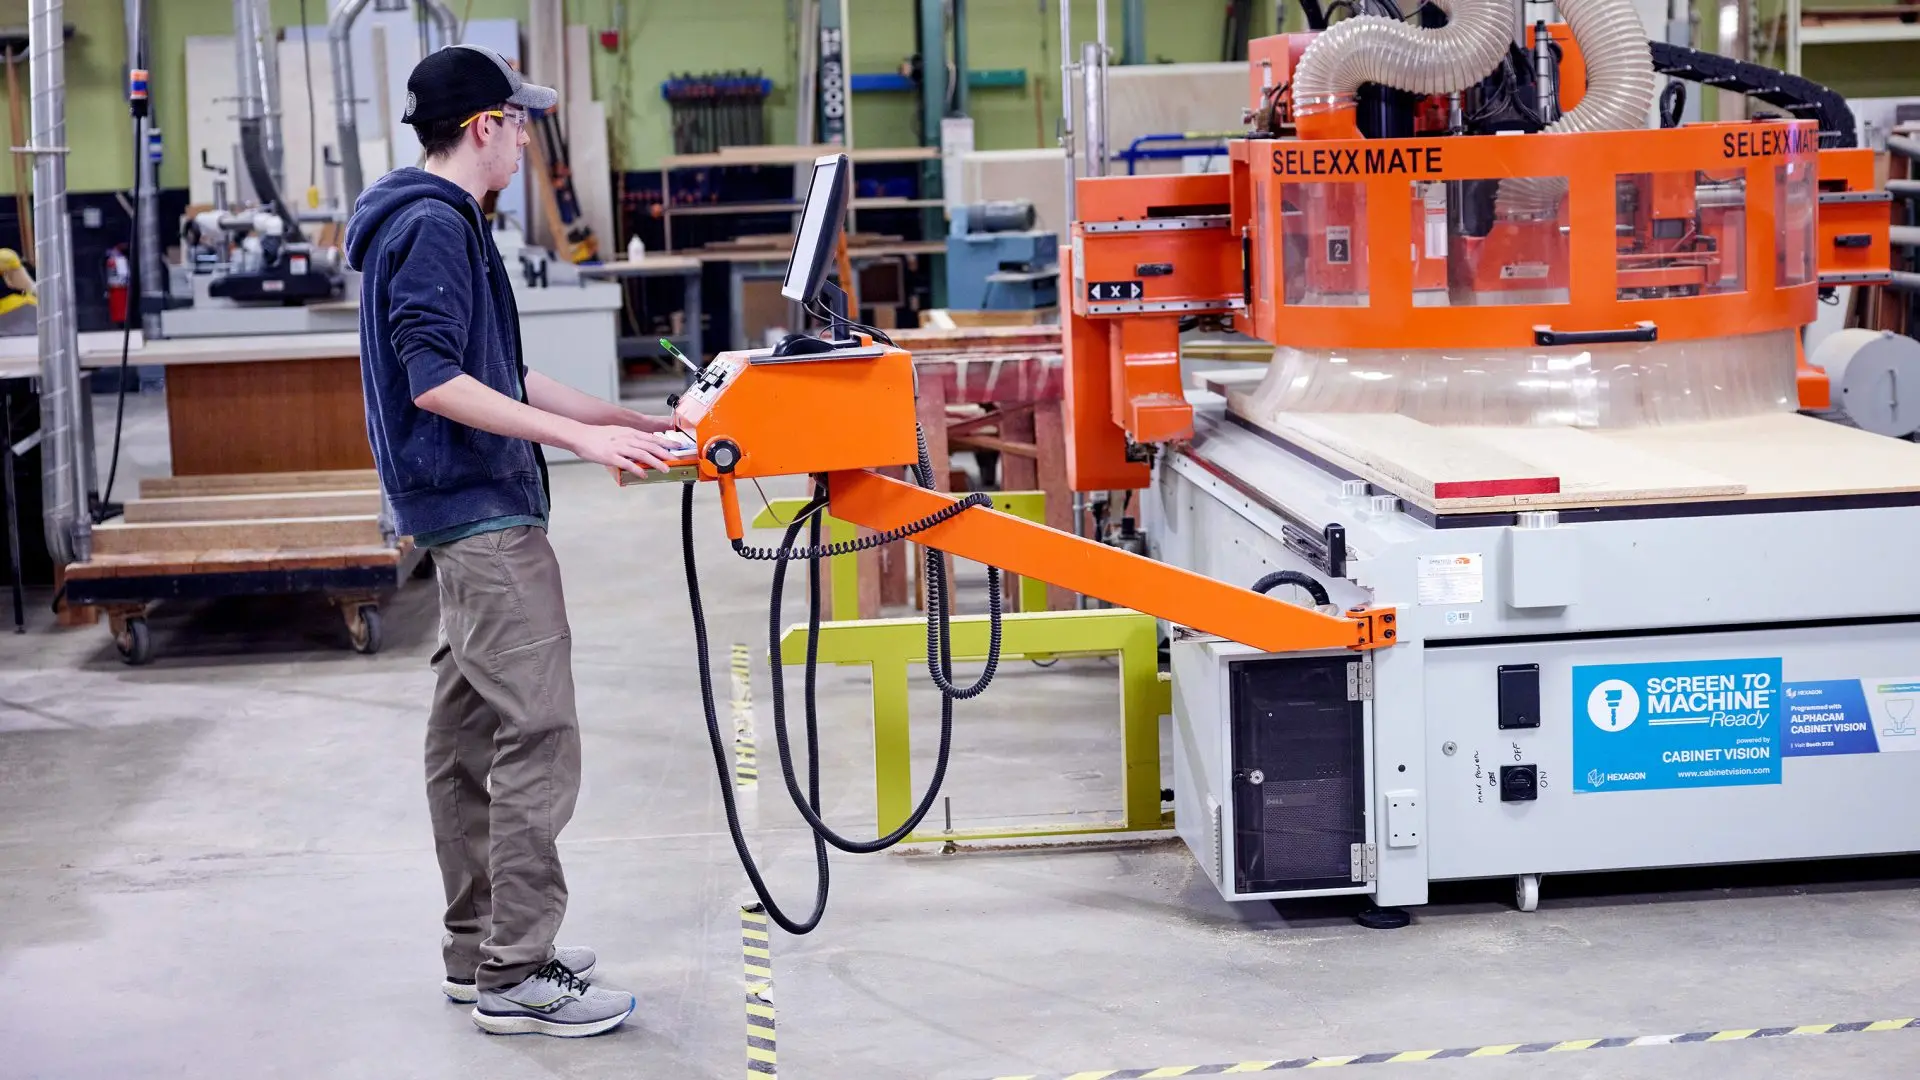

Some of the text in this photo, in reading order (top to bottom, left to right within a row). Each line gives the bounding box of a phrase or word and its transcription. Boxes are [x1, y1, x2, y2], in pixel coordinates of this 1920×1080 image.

[1723, 129, 1791, 158] SELEXX
[1272, 147, 1443, 175] SELEXX MATE
[1335, 243, 1343, 258] 2
[1110, 285, 1121, 297] X
[1647, 673, 1771, 694] SCREEN TO
[1710, 709, 1770, 729] Ready
[1790, 712, 1844, 723] ALPHACAM
[1791, 722, 1867, 734] CABINET VISION
[1662, 746, 1770, 763] CABINET VISION
[1539, 771, 1548, 788] ON
[1607, 772, 1646, 782] HEXAGON
[1677, 767, 1770, 778] www.cabinetvision.com
